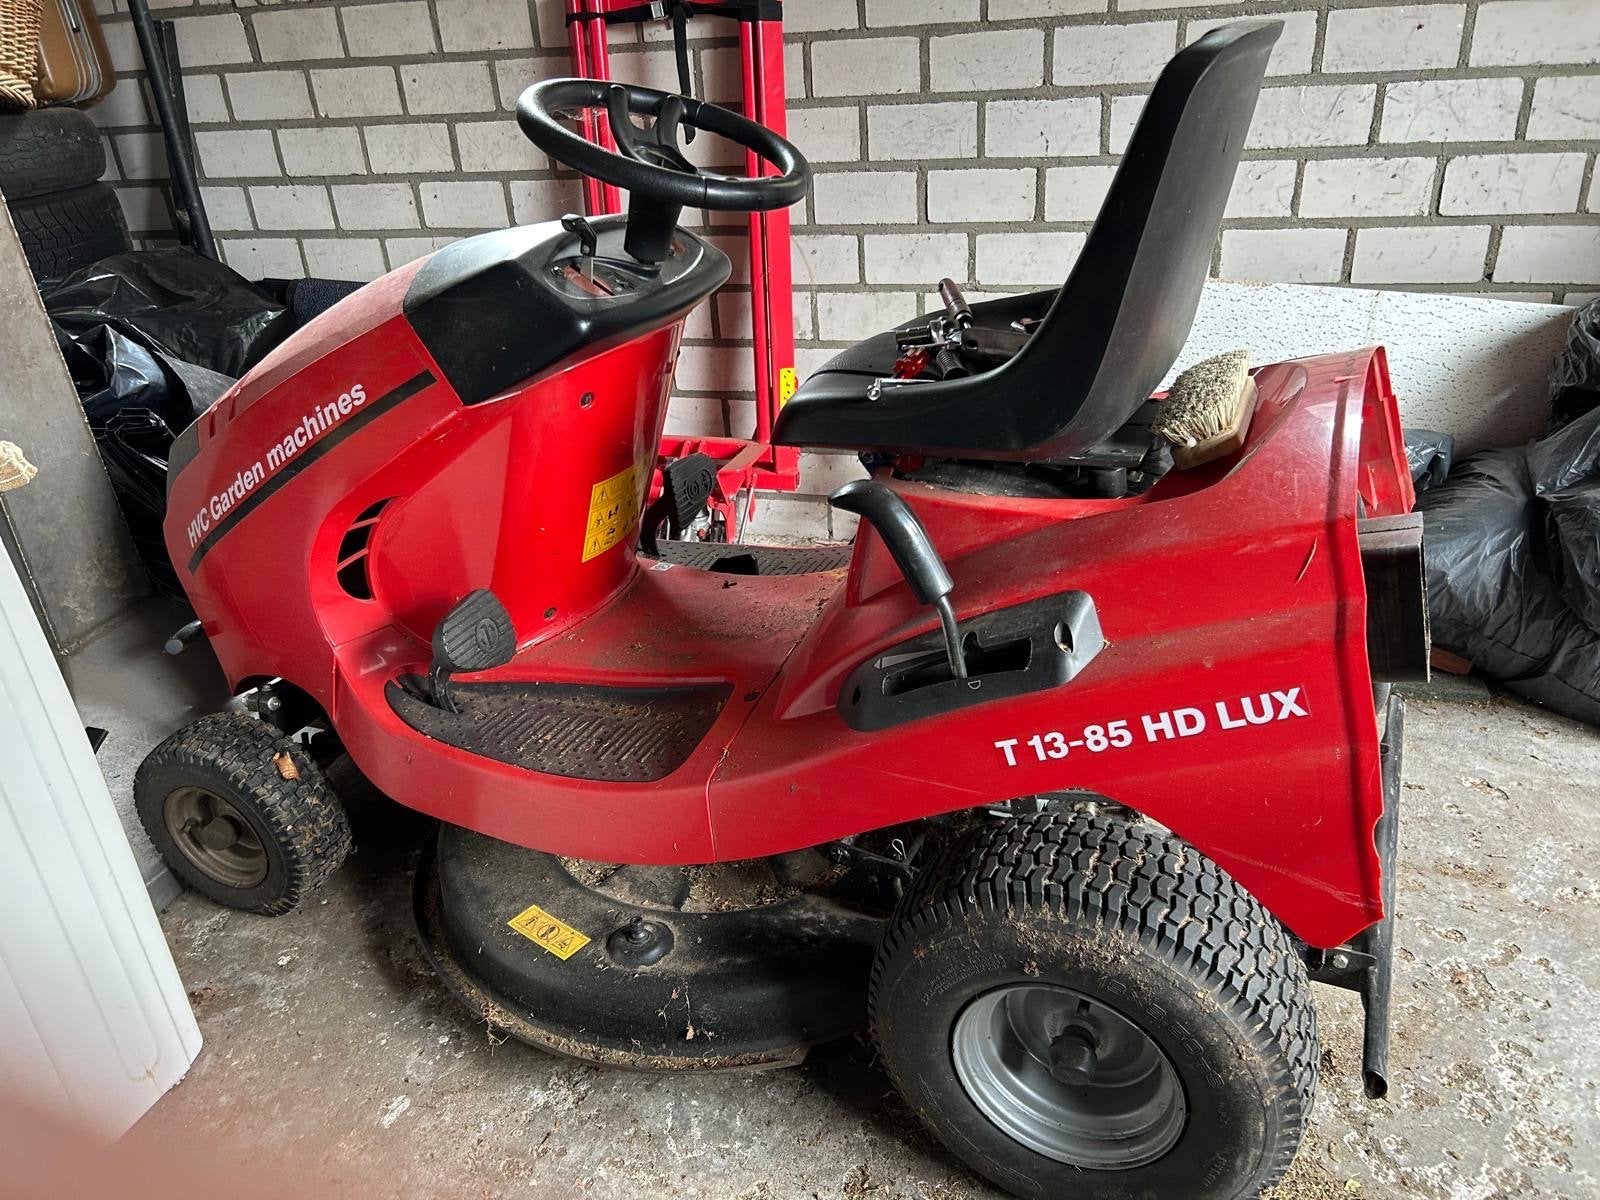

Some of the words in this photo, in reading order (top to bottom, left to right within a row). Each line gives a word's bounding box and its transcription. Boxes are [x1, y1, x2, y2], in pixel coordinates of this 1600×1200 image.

[187, 508, 210, 548] HVC
[210, 461, 265, 520] Garden
[266, 384, 367, 471] machines
[994, 739, 1018, 766] T
[1027, 720, 1133, 761] 13-85
[1141, 707, 1206, 742] HD
[1215, 687, 1309, 730] LUX
